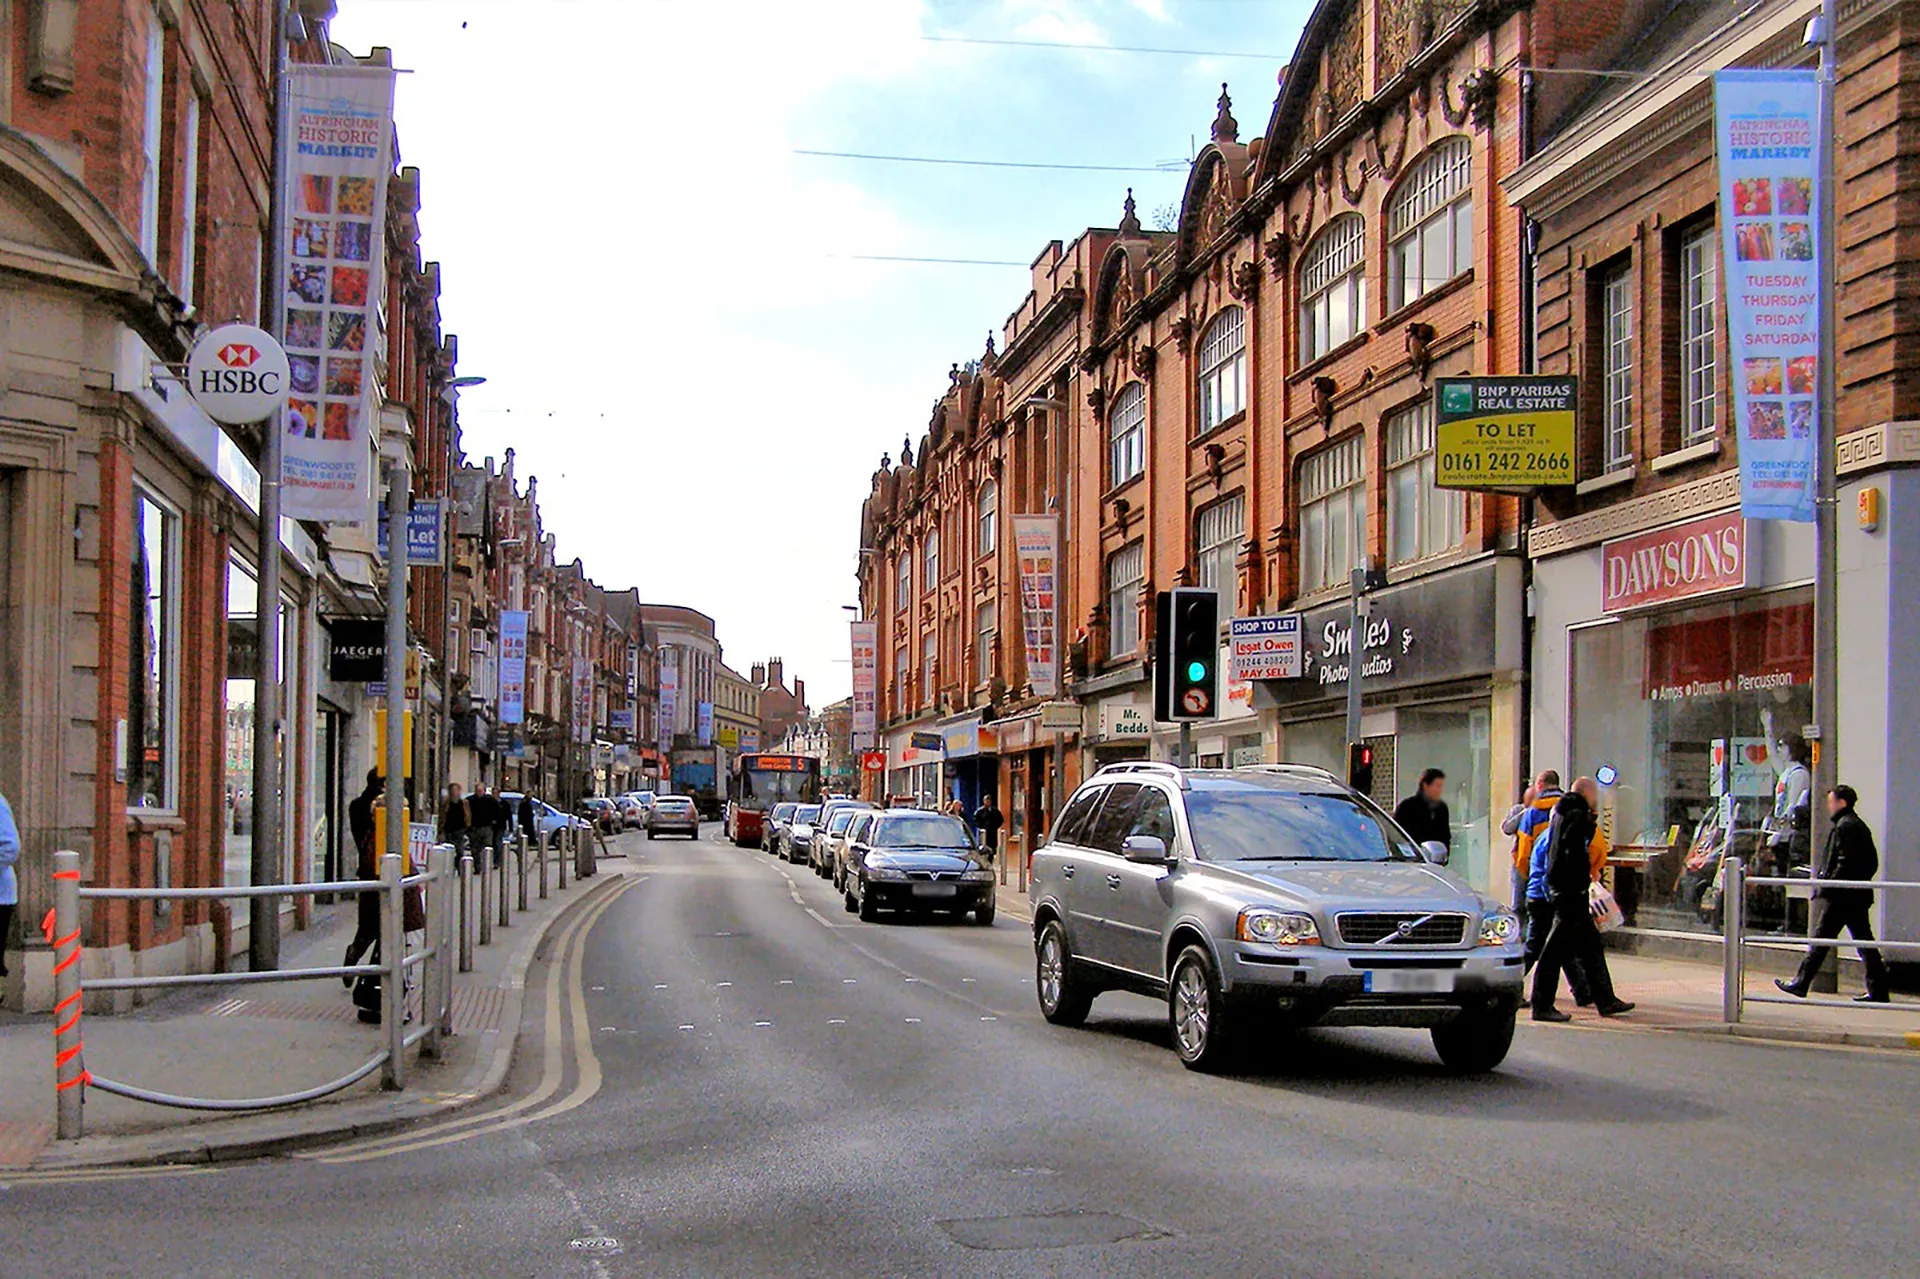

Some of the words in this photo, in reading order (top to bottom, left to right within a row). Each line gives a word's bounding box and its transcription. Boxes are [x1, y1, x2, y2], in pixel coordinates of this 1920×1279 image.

[298, 127, 378, 144] HISTORIC
[1730, 132, 1811, 146] HISTORIC
[297, 142, 377, 158] MARKET
[1730, 147, 1811, 159] MARKET
[1745, 275, 1807, 287] TUESDAY
[1741, 293, 1816, 307] THURSDAY
[1755, 312, 1807, 326] FRIDAY
[1744, 332, 1817, 345] SATURDAY
[200, 369, 280, 395] HSBC
[1478, 386, 1507, 397] BNP
[1511, 384, 1570, 396] PARIBAS
[1478, 398, 1513, 409] REAL
[1516, 398, 1566, 408] ESTATE
[1476, 424, 1500, 437] TO
[1508, 424, 1536, 437] LET
[1443, 453, 1480, 471] 0161
[1488, 453, 1520, 470] 242
[1526, 452, 1569, 470] 2666
[414, 514, 436, 525] Unit
[409, 528, 436, 544] Let
[1608, 526, 1739, 600] DAWSONS
[1234, 621, 1259, 633] SHOP
[1262, 621, 1276, 632] TO
[1278, 619, 1296, 630] LET
[1322, 616, 1391, 658] Smles
[333, 646, 383, 656] JAEGER
[1236, 640, 1261, 656] Legat
[1264, 639, 1293, 651] Owen
[1240, 669, 1263, 679] MAY
[1266, 668, 1289, 677] SELL
[1320, 664, 1349, 685] Photo
[1361, 654, 1392, 677] udios
[1659, 684, 1684, 701] Amps
[1692, 680, 1722, 696] Drums
[1737, 668, 1792, 691] Percussion
[1123, 709, 1141, 719] Mr.
[1115, 722, 1148, 733] Bedds
[797, 758, 805, 771] 5
